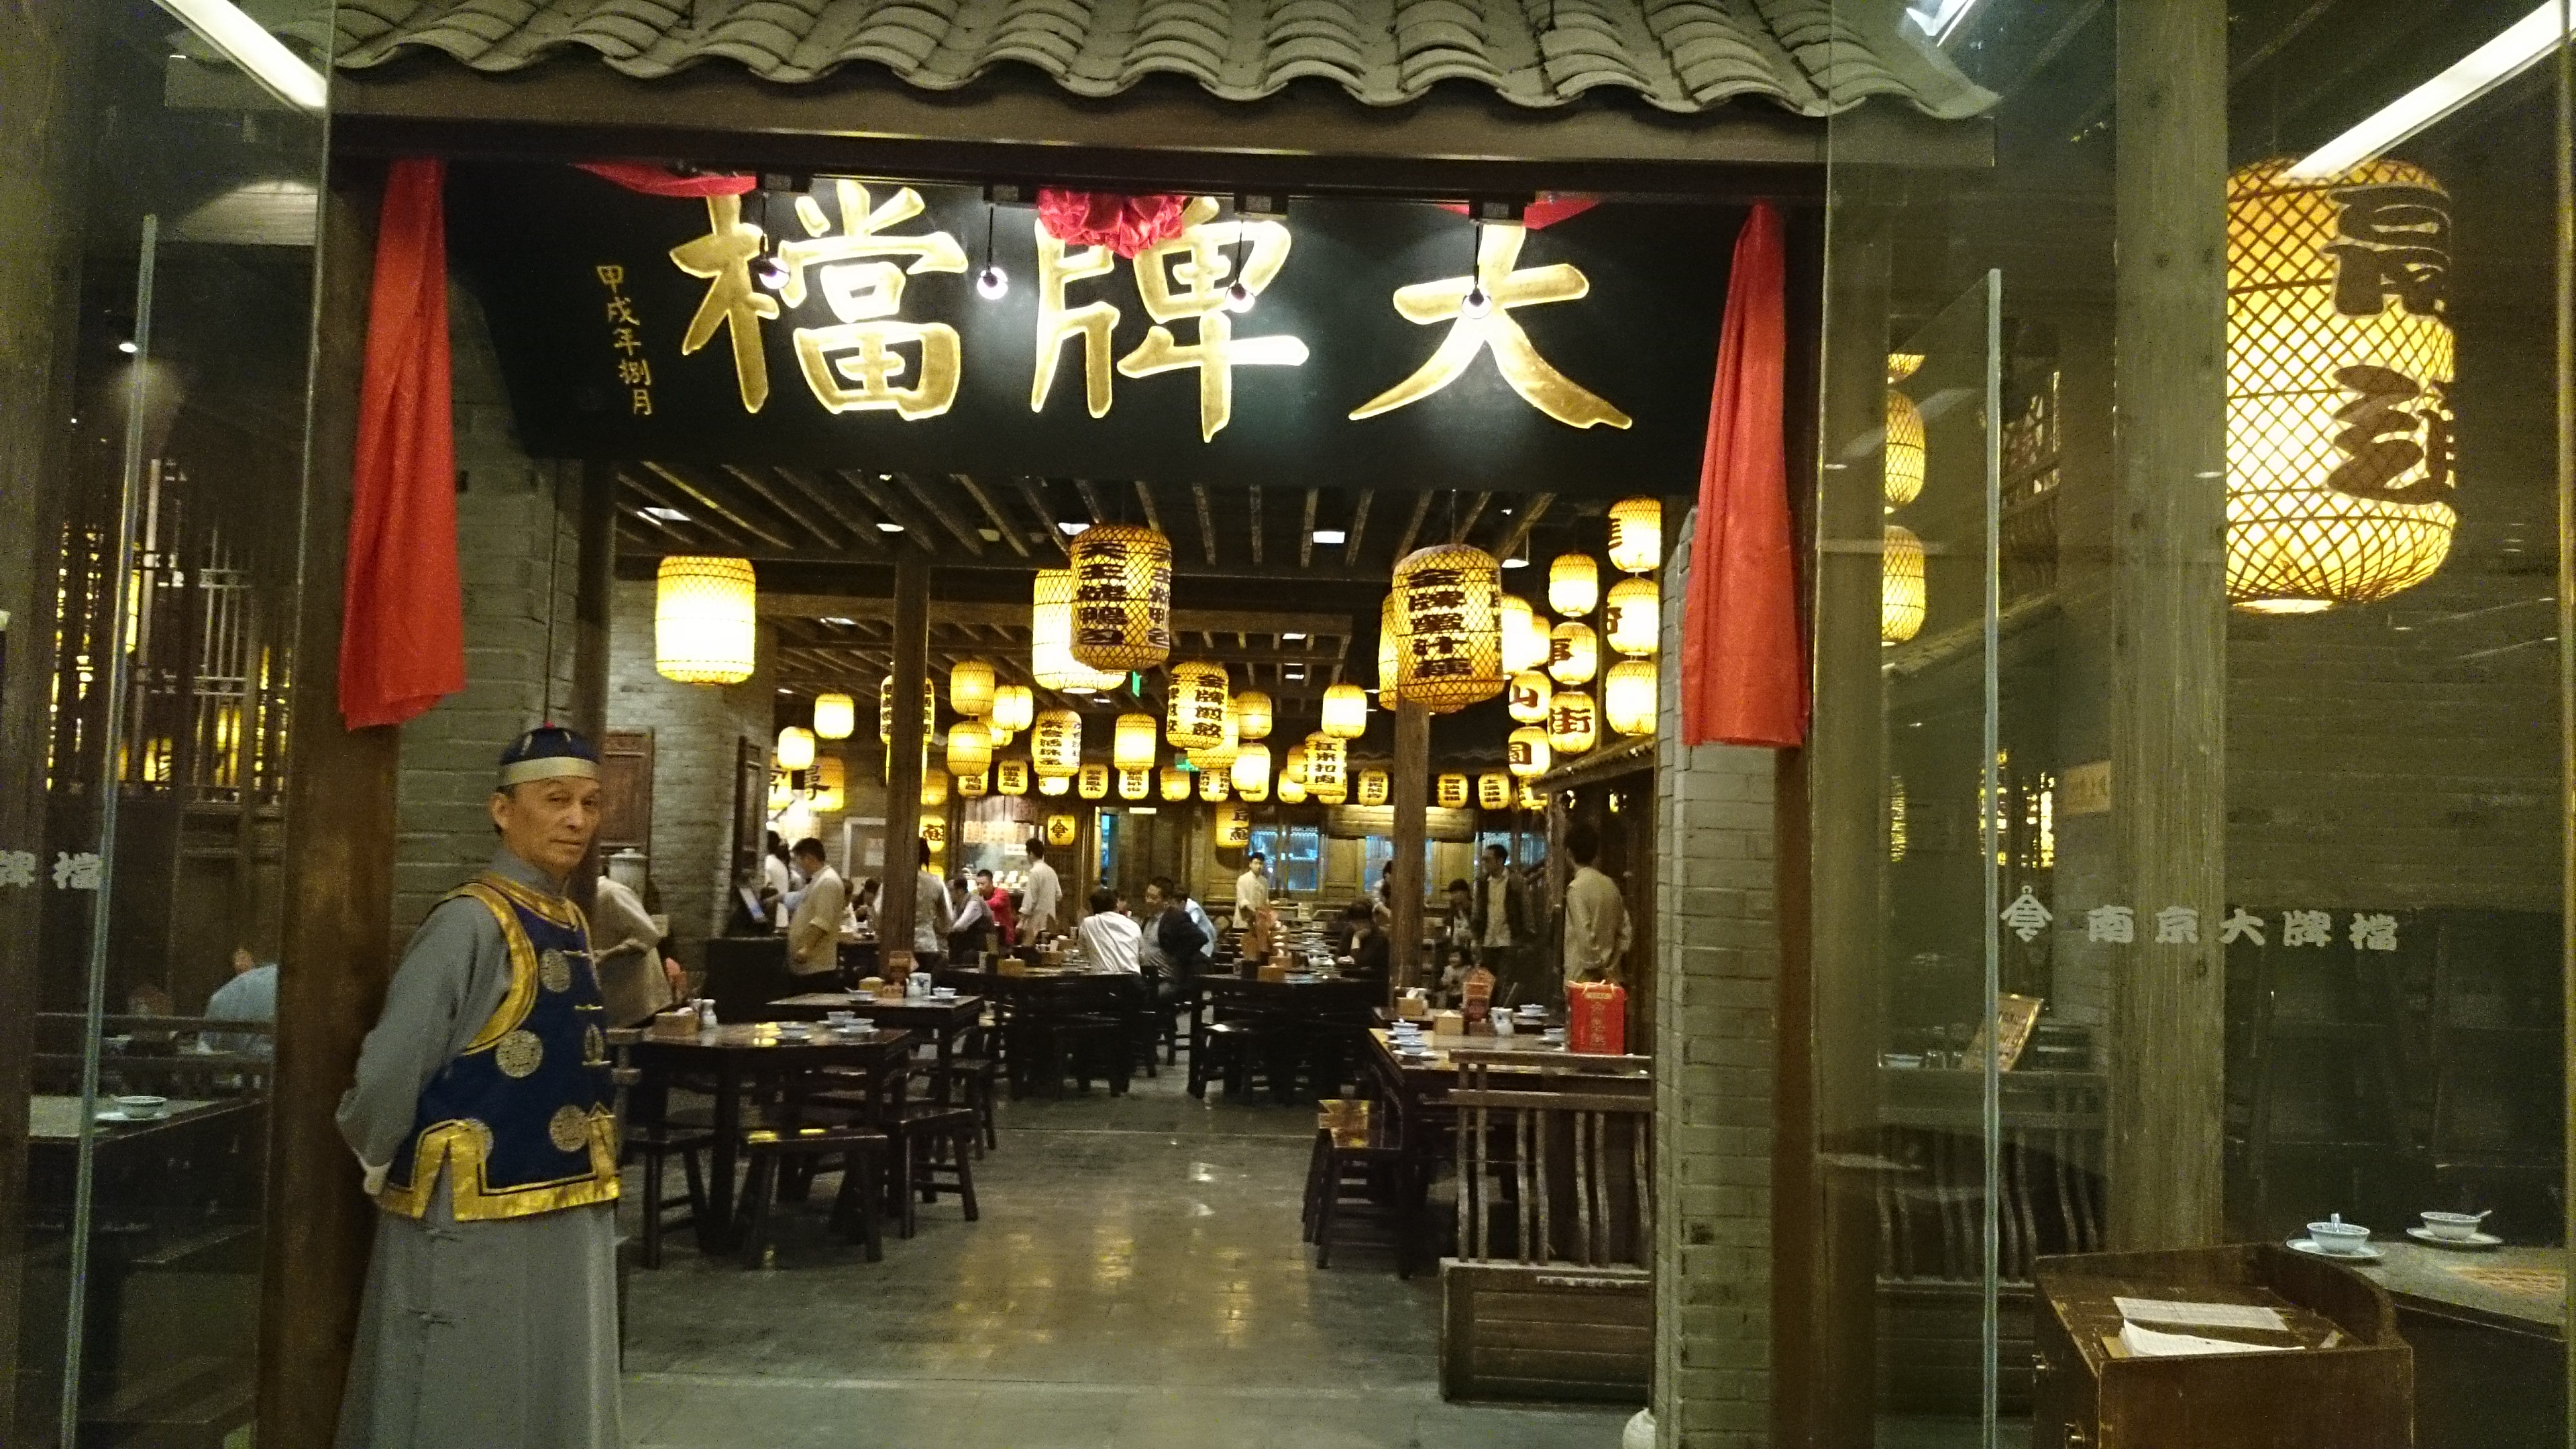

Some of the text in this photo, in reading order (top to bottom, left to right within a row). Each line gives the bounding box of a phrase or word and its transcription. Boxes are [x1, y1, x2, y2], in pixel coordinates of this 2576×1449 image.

[2087, 904, 2398, 951] 南京大牌檔
